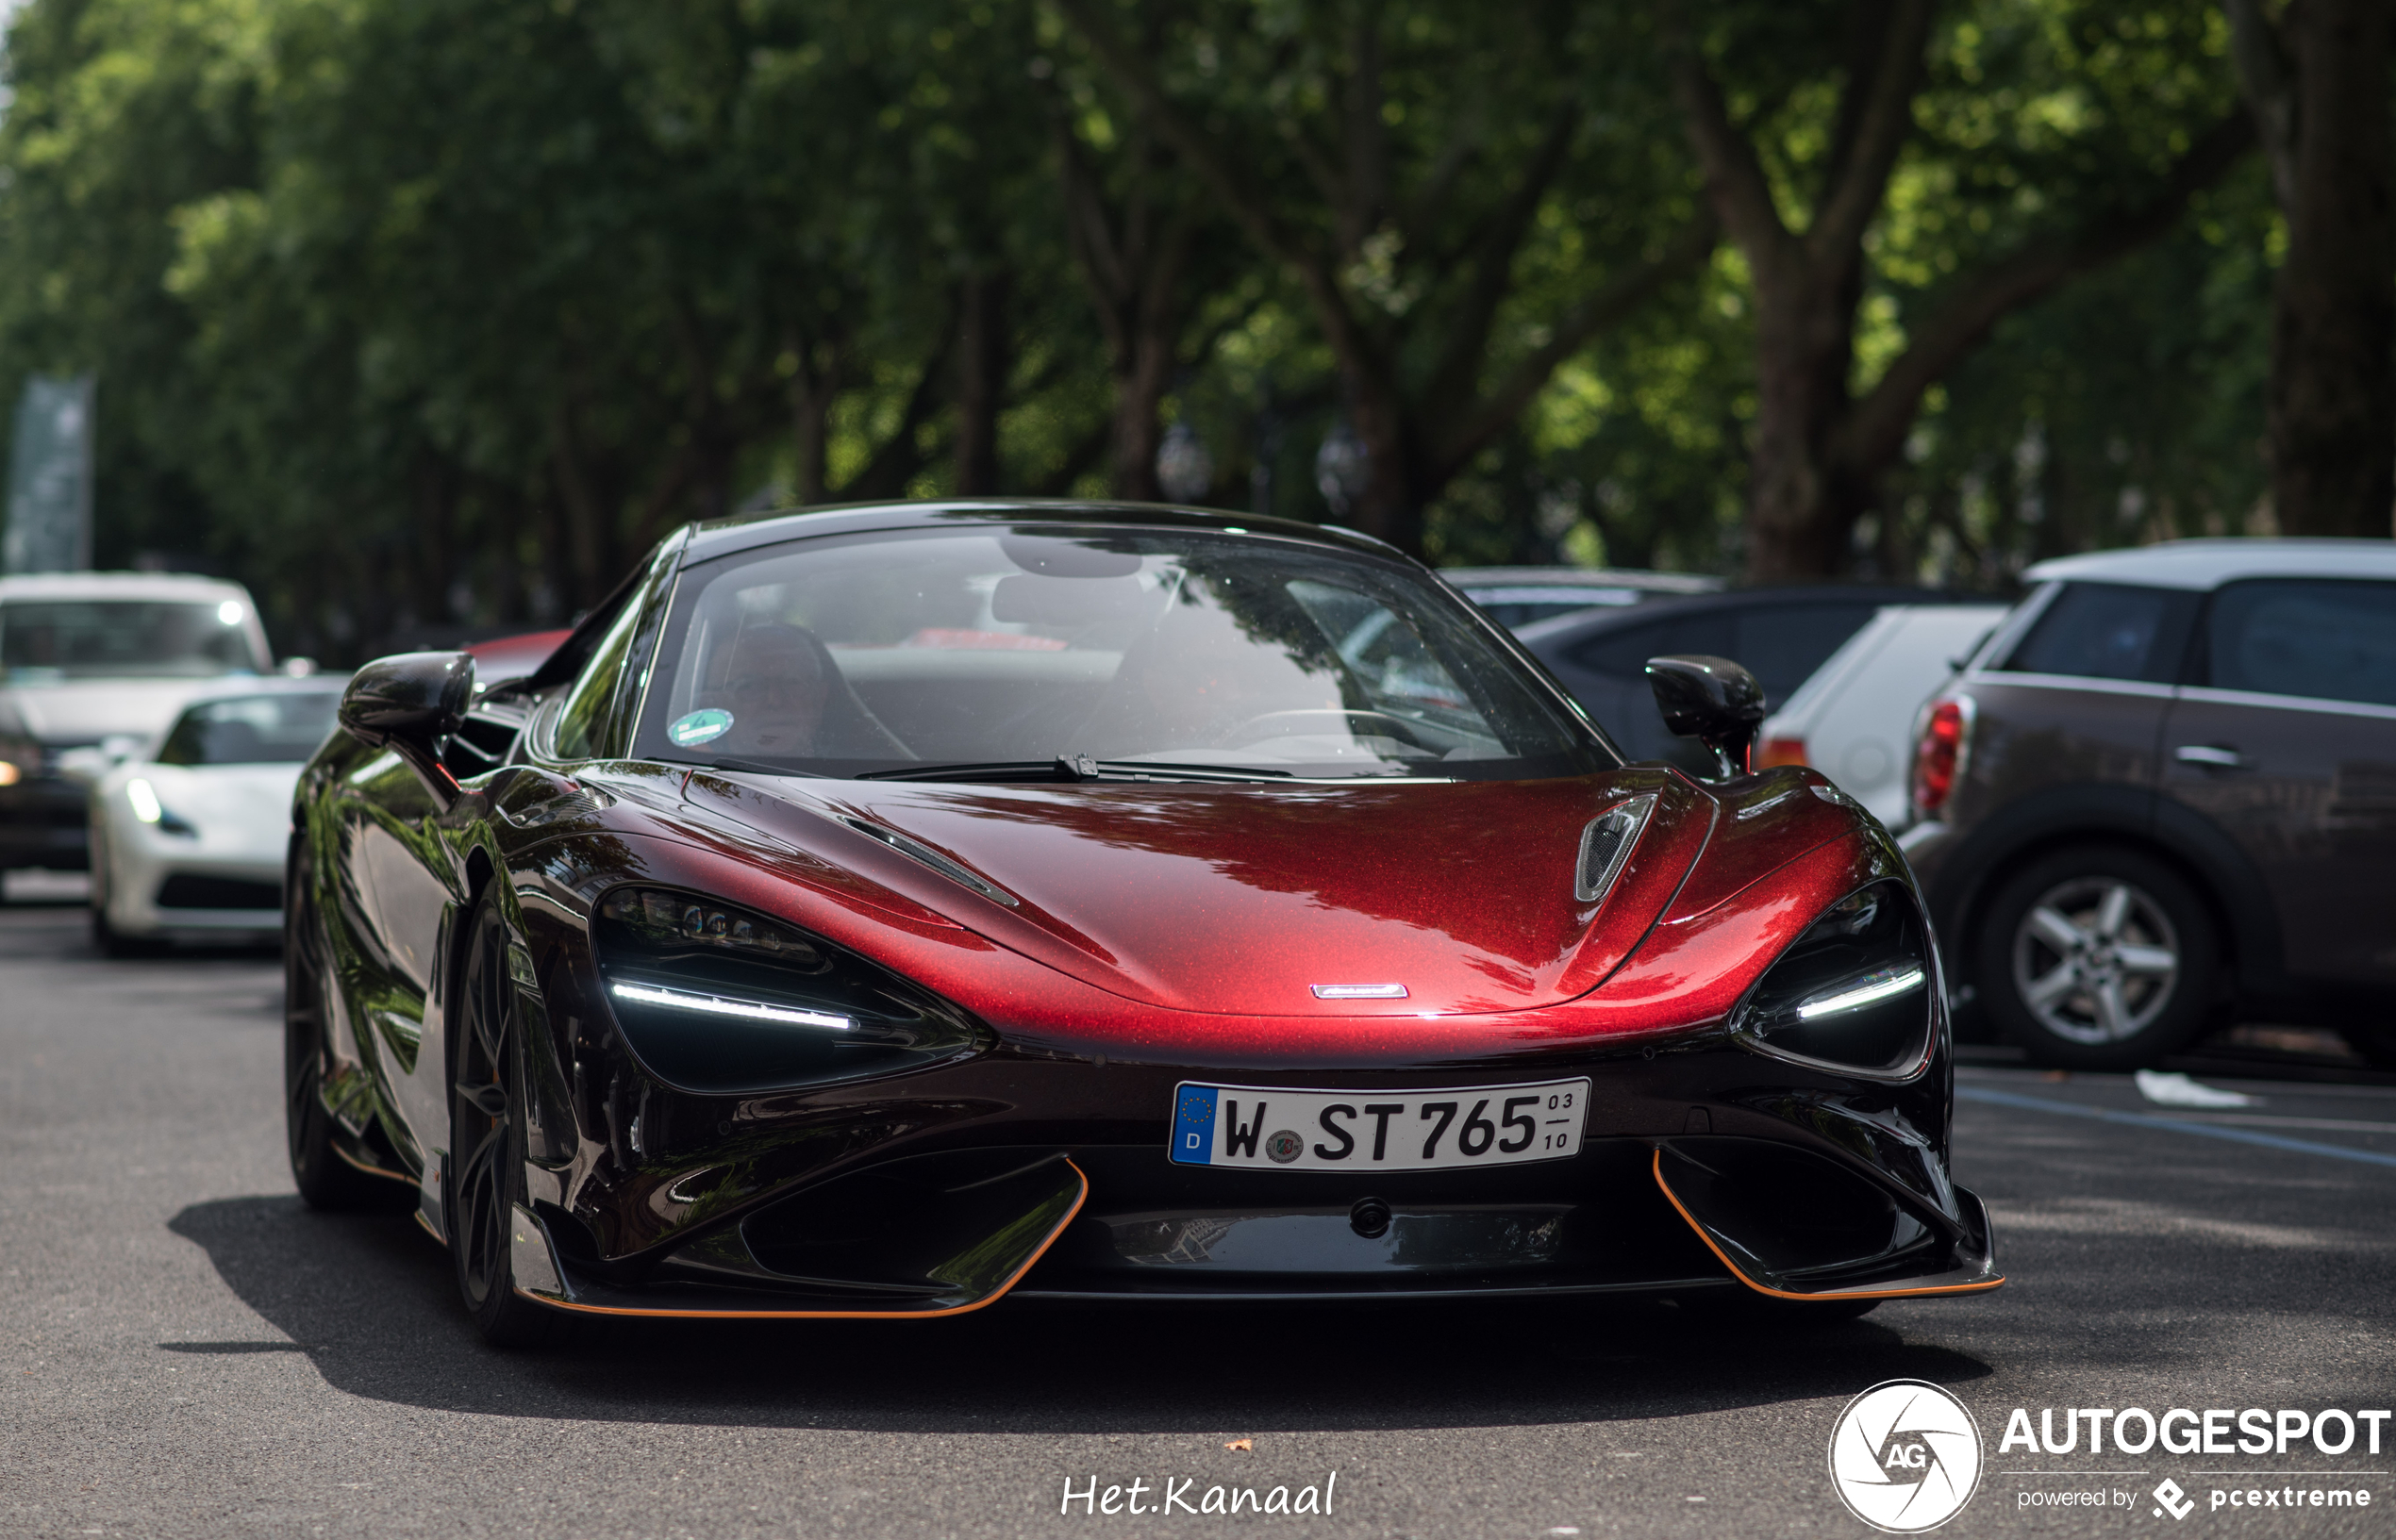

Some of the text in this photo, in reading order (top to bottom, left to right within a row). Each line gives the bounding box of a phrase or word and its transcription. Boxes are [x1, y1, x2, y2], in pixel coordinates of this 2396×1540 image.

[1548, 1093, 1573, 1110] 03
[1225, 1095, 1540, 1161] W ST 765
[1186, 1133, 1201, 1150] D
[1544, 1133, 1568, 1151] 10
